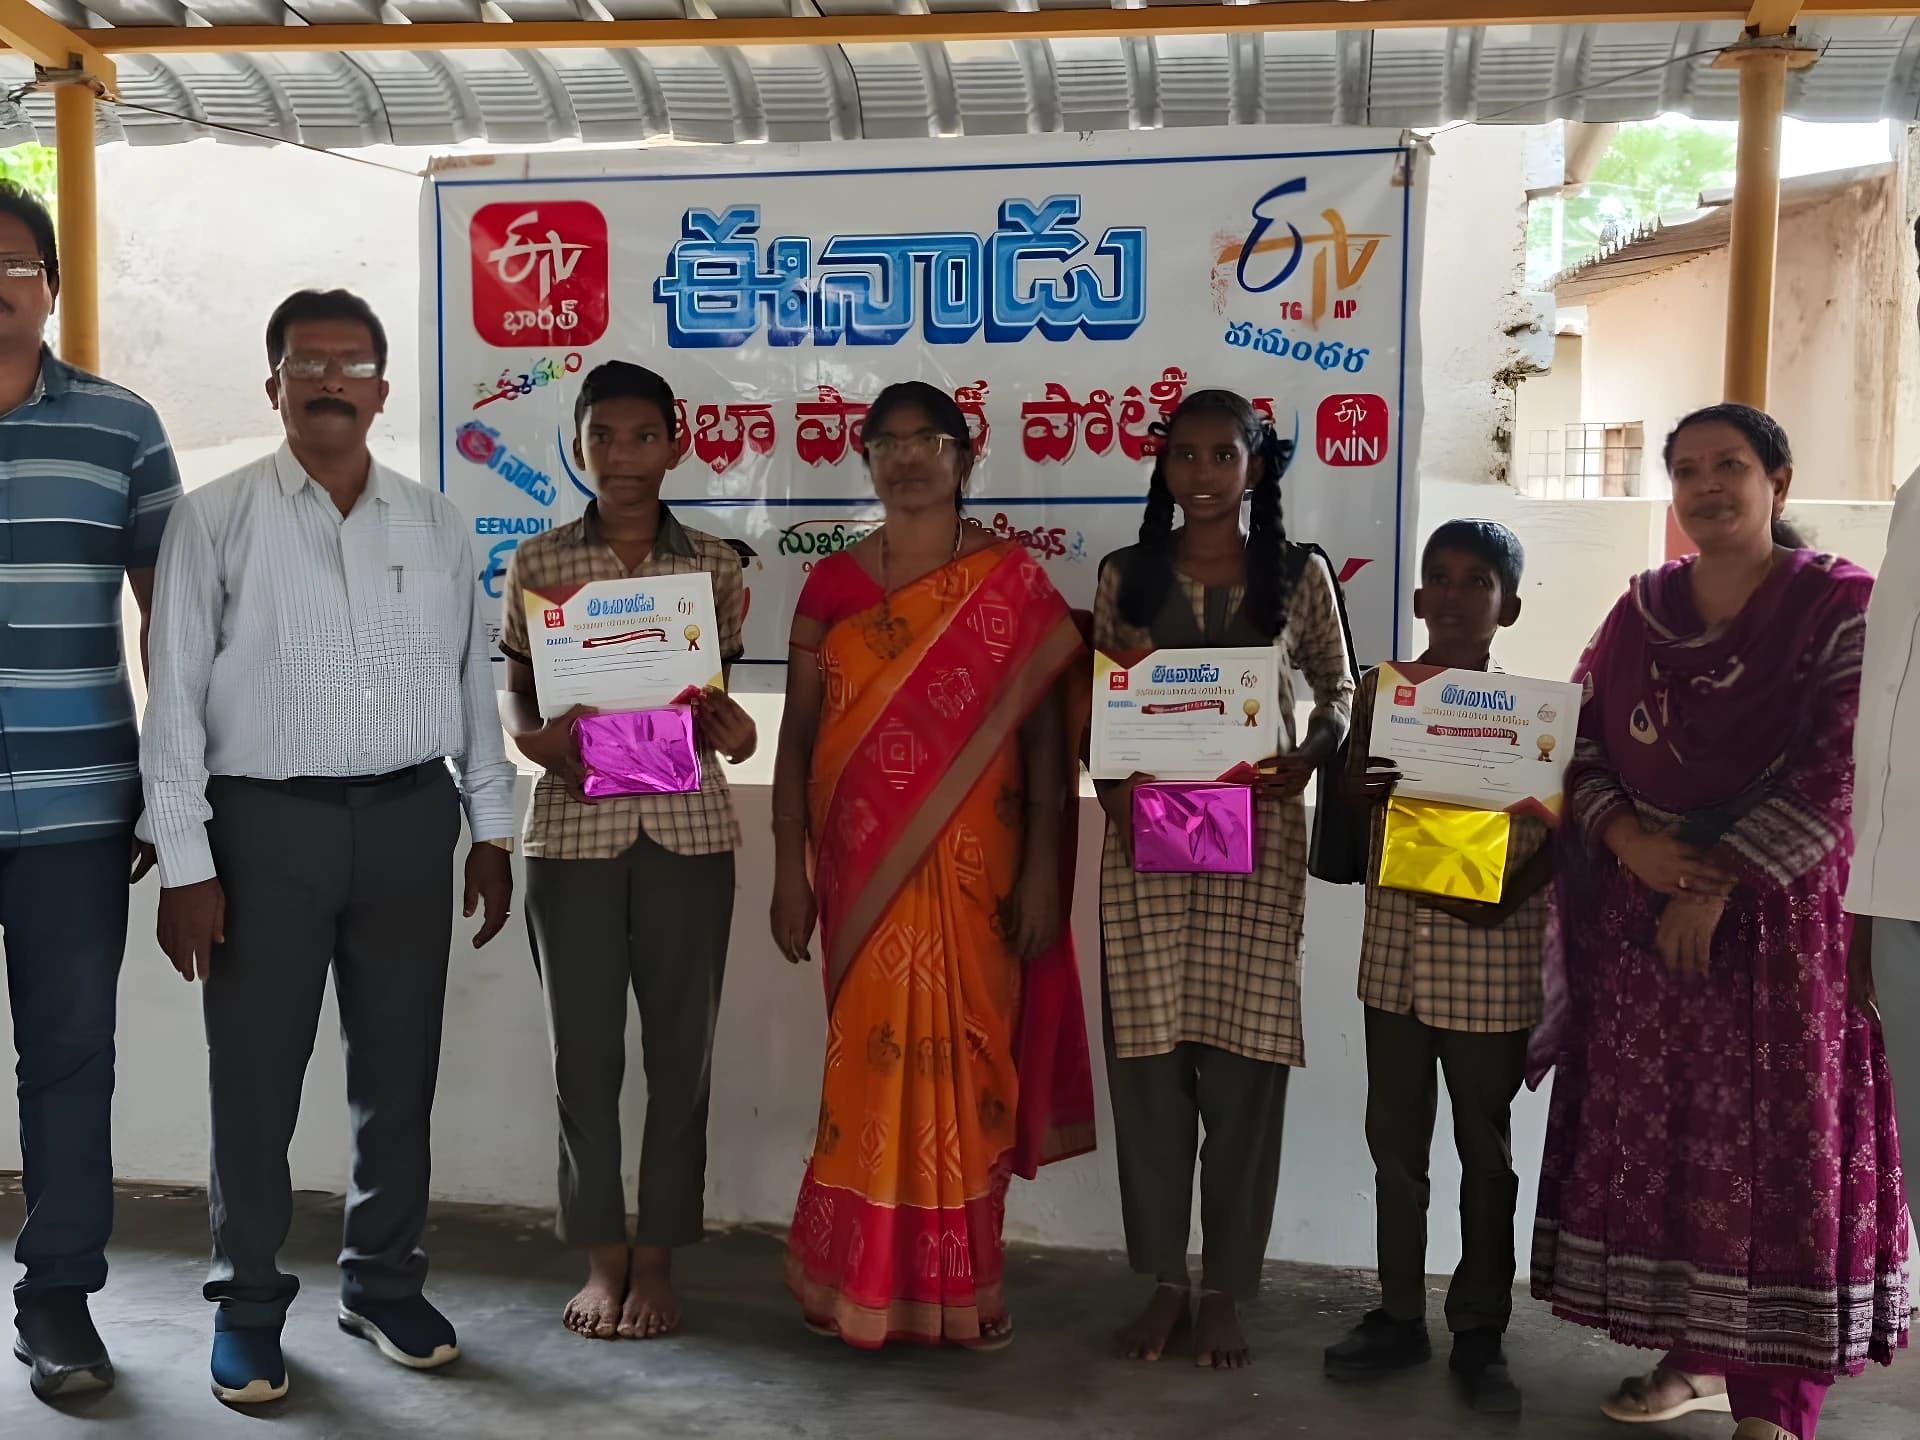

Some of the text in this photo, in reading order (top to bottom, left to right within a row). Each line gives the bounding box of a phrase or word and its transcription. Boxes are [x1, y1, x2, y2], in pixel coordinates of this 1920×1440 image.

[653, 194, 1147, 349] ఈనాడు
[503, 299, 579, 336] భారత్
[1280, 301, 1303, 320] TG
[1334, 300, 1357, 319] AP
[1224, 321, 1370, 373] వసుంధర
[475, 517, 553, 534] EENADU
